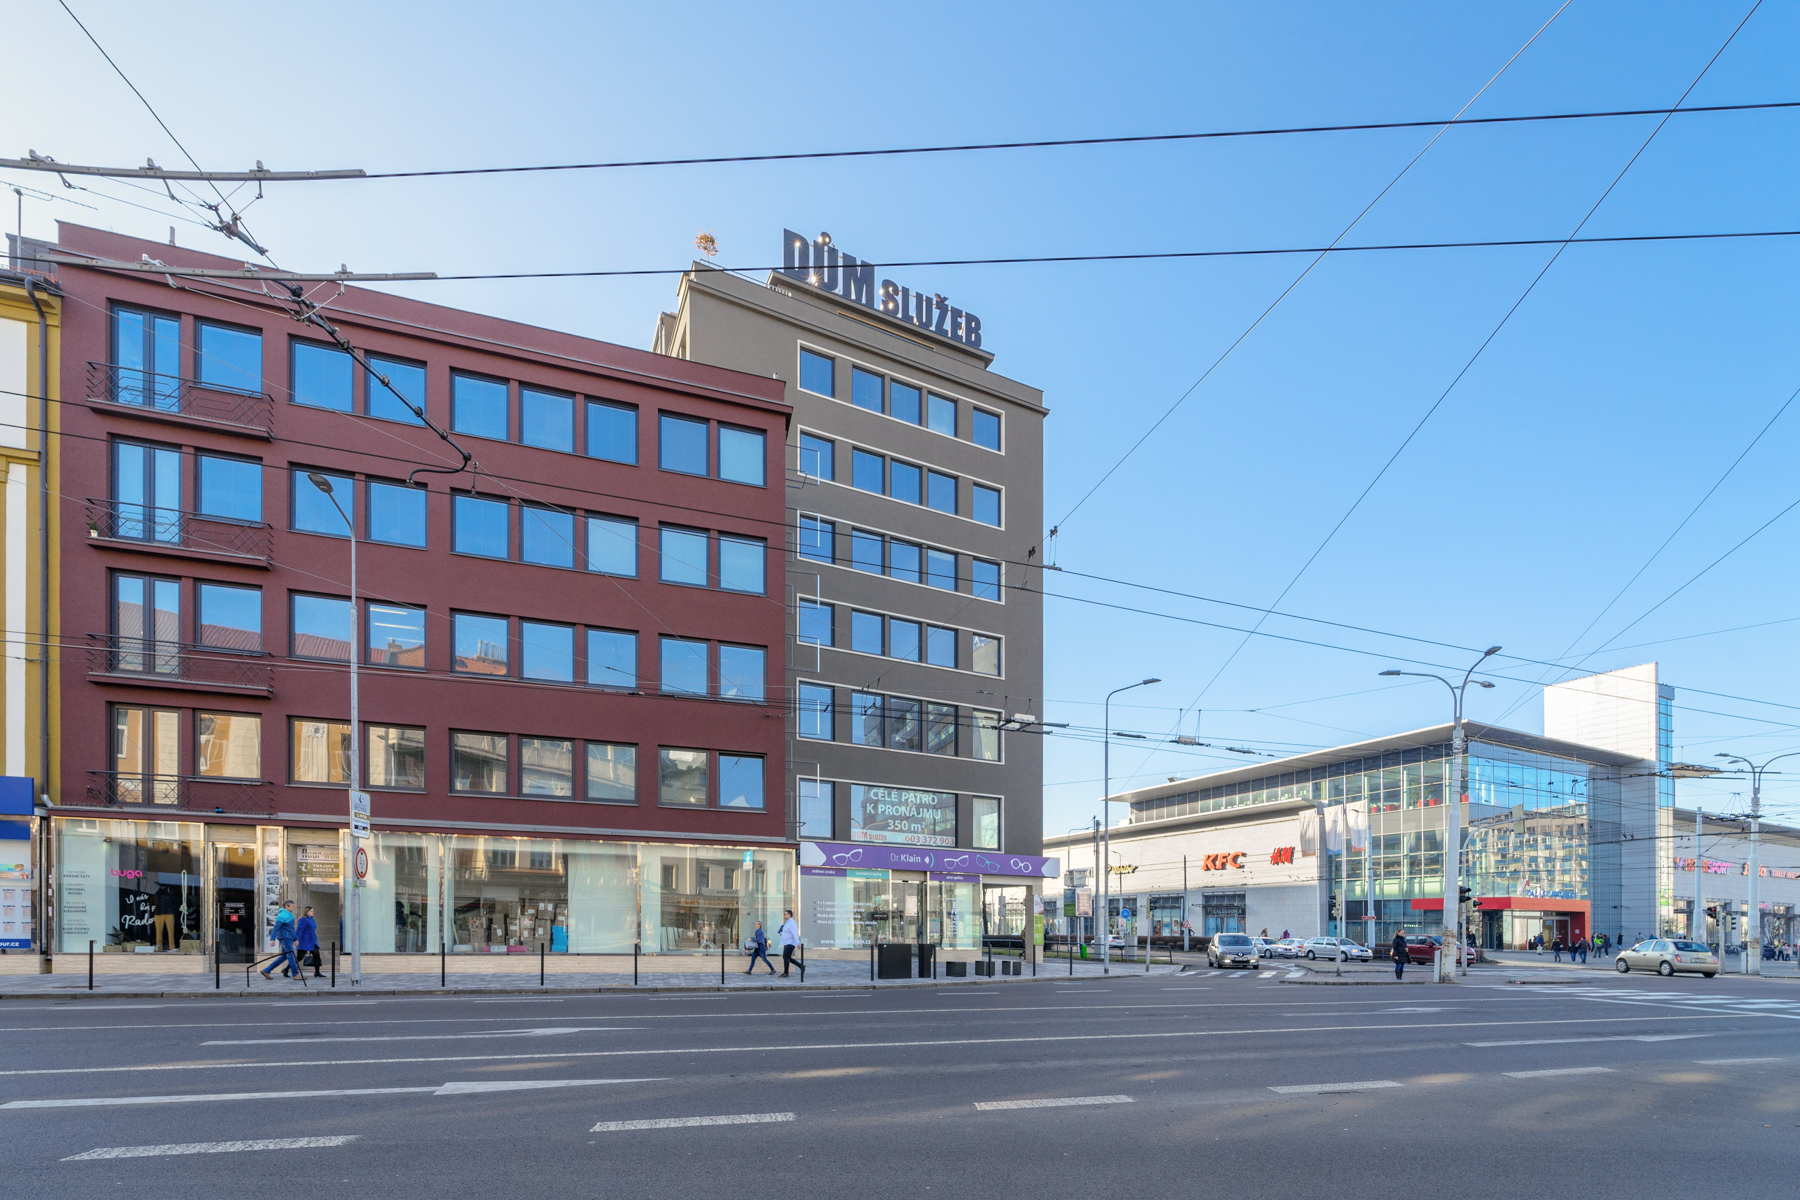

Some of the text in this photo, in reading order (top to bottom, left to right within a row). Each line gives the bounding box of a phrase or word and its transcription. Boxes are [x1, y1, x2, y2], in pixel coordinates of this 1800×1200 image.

[783, 228, 982, 348] DŮM SLUŽEB
[870, 789, 938, 805] CELÉ PATRO
[354, 804, 368, 814] ROYAL
[866, 803, 941, 819] K PRONÁJMU
[887, 819, 909, 831] 350
[851, 831, 887, 841] DŮM SLUŽEB
[905, 835, 955, 845] 603 372 903
[1201, 851, 1244, 871] KFC
[1270, 846, 1293, 866] H&M
[110, 867, 143, 879] buga
[1685, 858, 1731, 875] INTRSPORT
[121, 913, 156, 929] Rado
